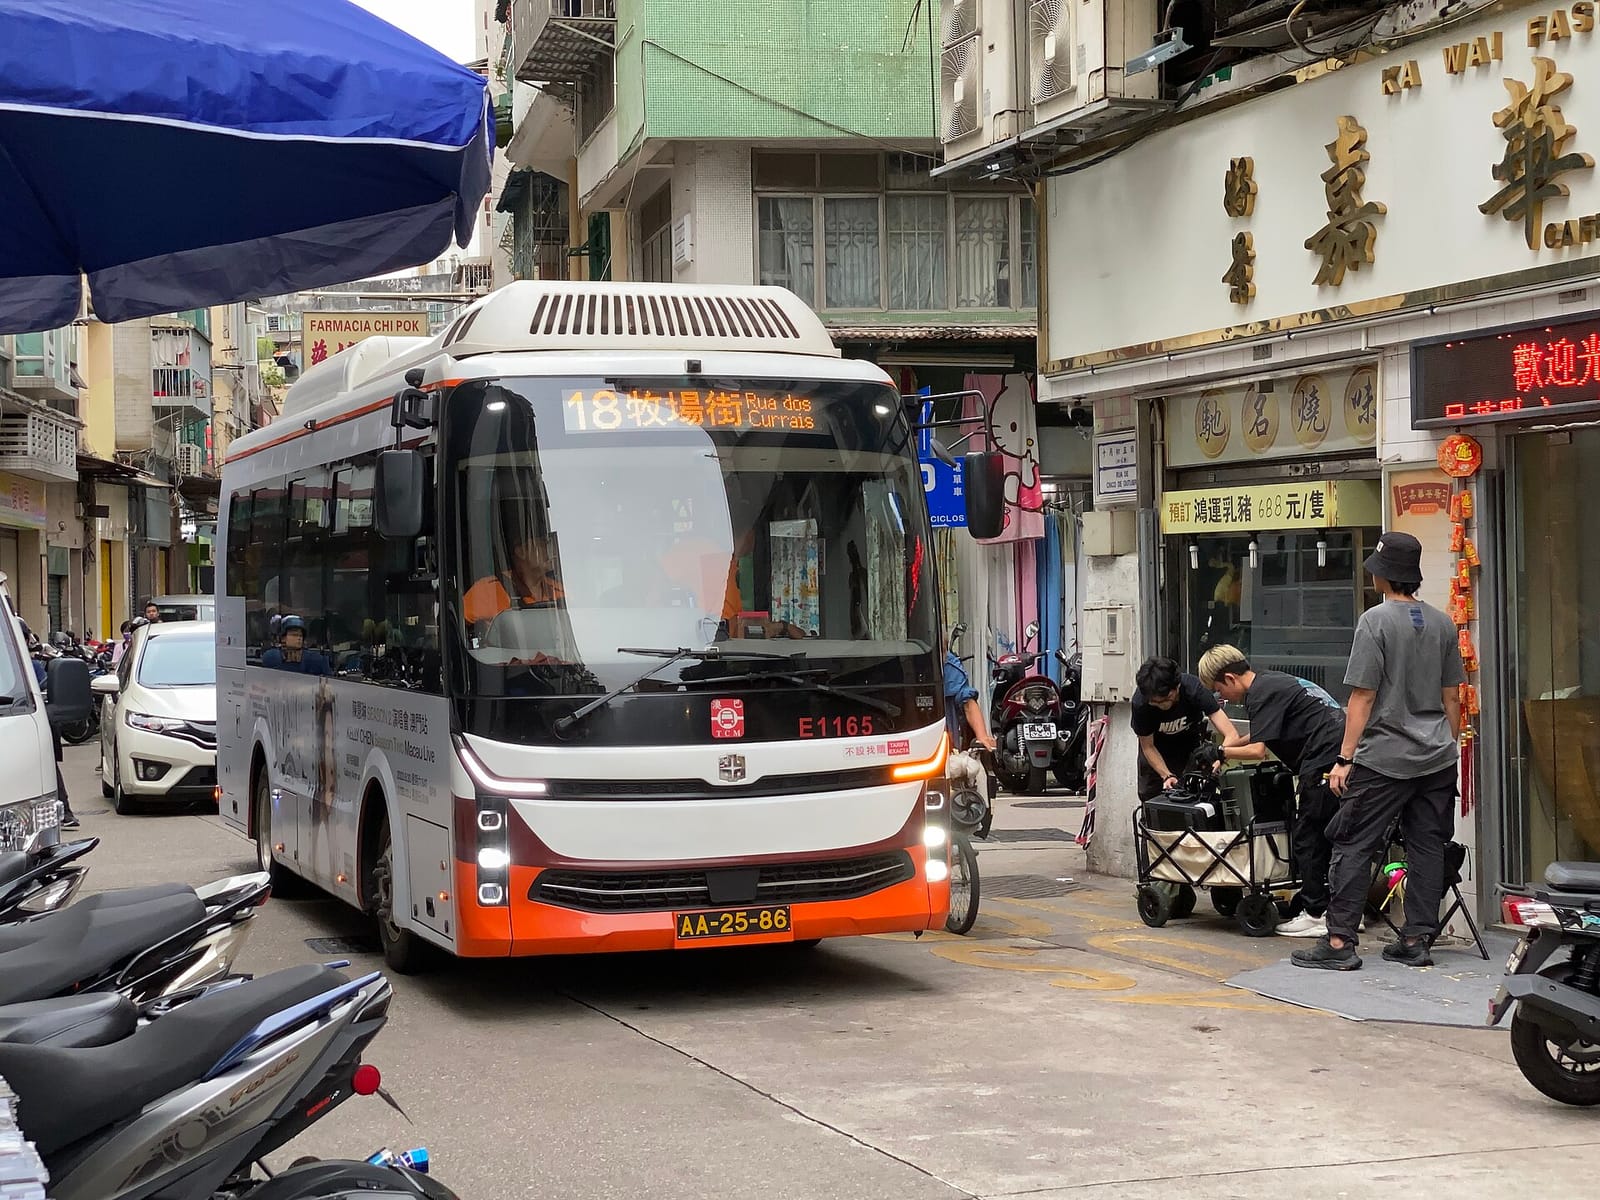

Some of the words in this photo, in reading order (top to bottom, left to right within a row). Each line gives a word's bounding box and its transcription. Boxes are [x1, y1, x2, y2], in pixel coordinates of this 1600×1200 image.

[1382, 59, 1422, 96] KA
[1442, 31, 1503, 75] WAI
[1527, 0, 1600, 48] FAS
[1545, 212, 1600, 249] CAF
[310, 320, 372, 332] FARMACIA
[374, 320, 393, 332] CHI
[396, 320, 419, 332] POK
[567, 389, 622, 431] 18
[745, 392, 776, 410] Rua
[783, 393, 812, 411] dos
[748, 409, 815, 430] Currais
[1169, 501, 1191, 523] 預訂
[1193, 494, 1252, 524] 鴻運乳豬
[1258, 494, 1282, 518] 688
[799, 716, 873, 737] E1165
[1159, 716, 1187, 732] NIKE
[404, 739, 422, 760] Macau
[423, 744, 435, 763] Live
[681, 909, 788, 936] AA-25-86
